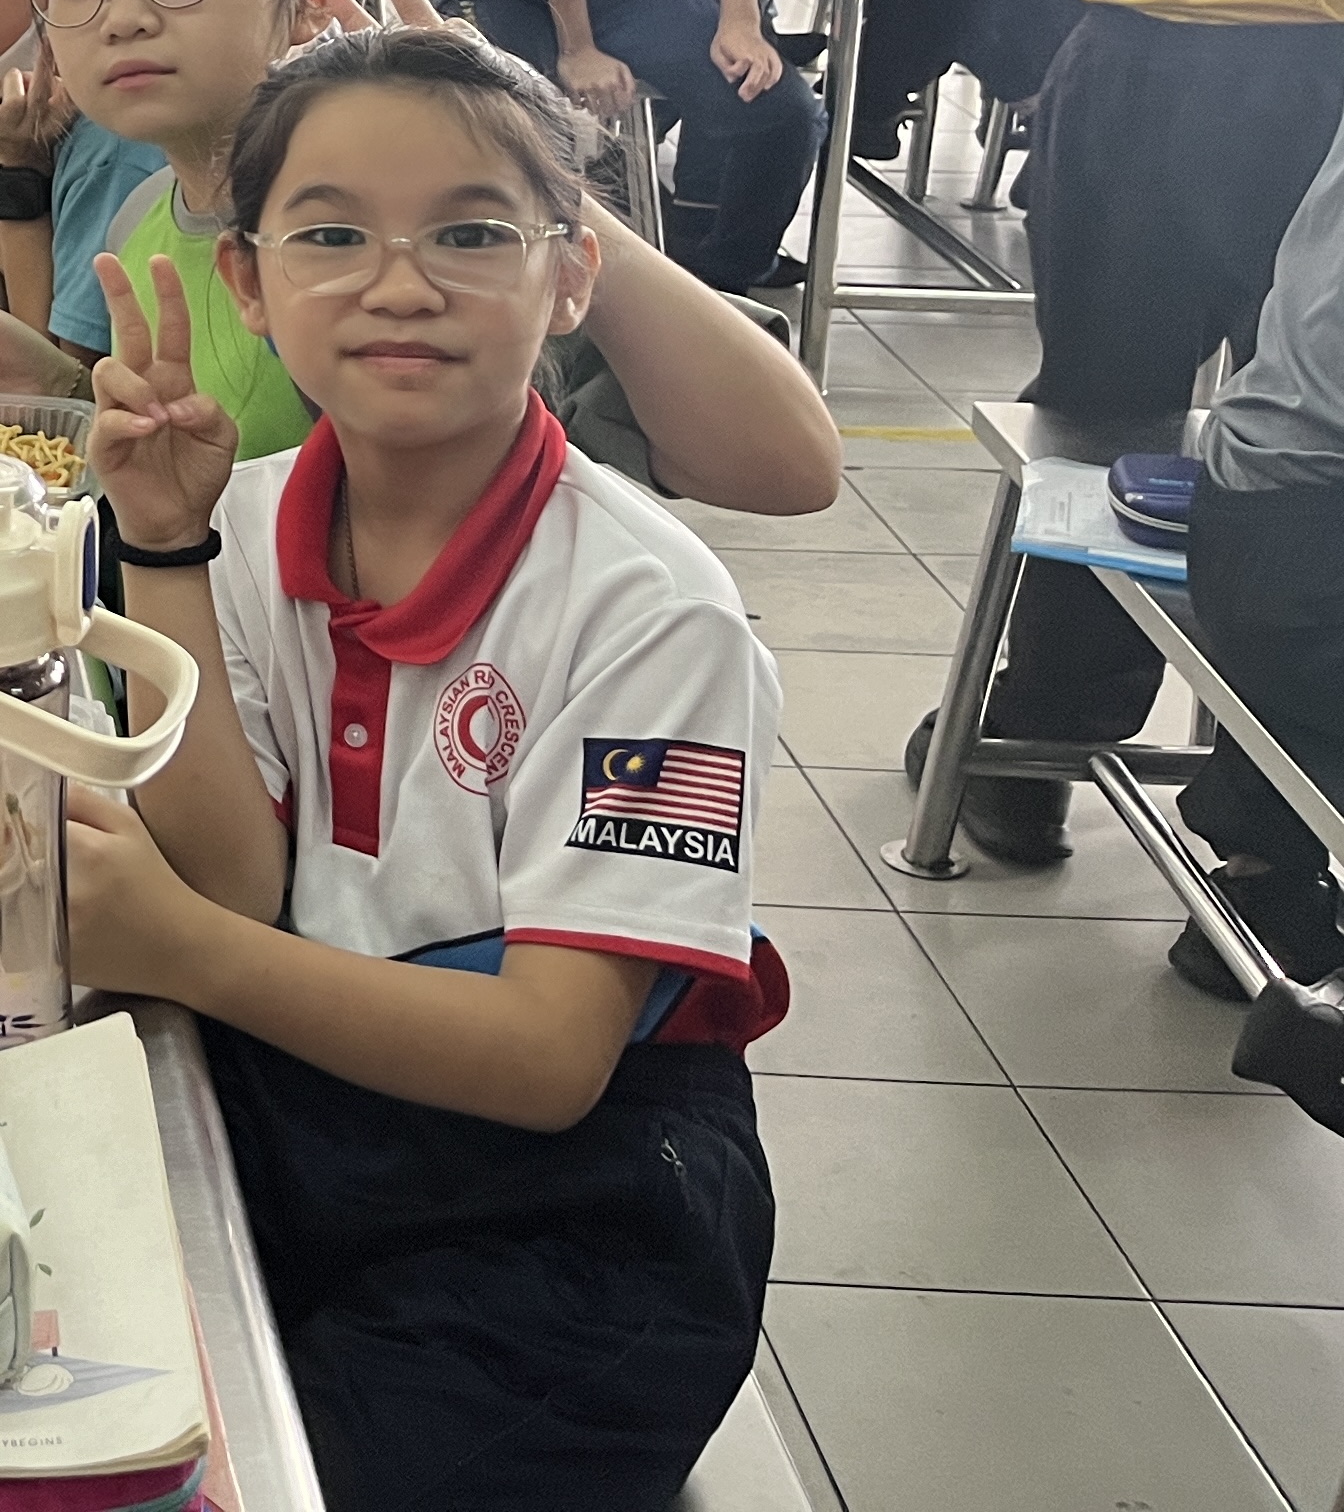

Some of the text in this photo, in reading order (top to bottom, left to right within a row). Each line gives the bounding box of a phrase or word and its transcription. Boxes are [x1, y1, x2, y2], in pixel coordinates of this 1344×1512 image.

[439, 676, 471, 779] MALAYSIAN
[486, 691, 521, 775] CRESCEN
[570, 817, 736, 867] MALAYSIA
